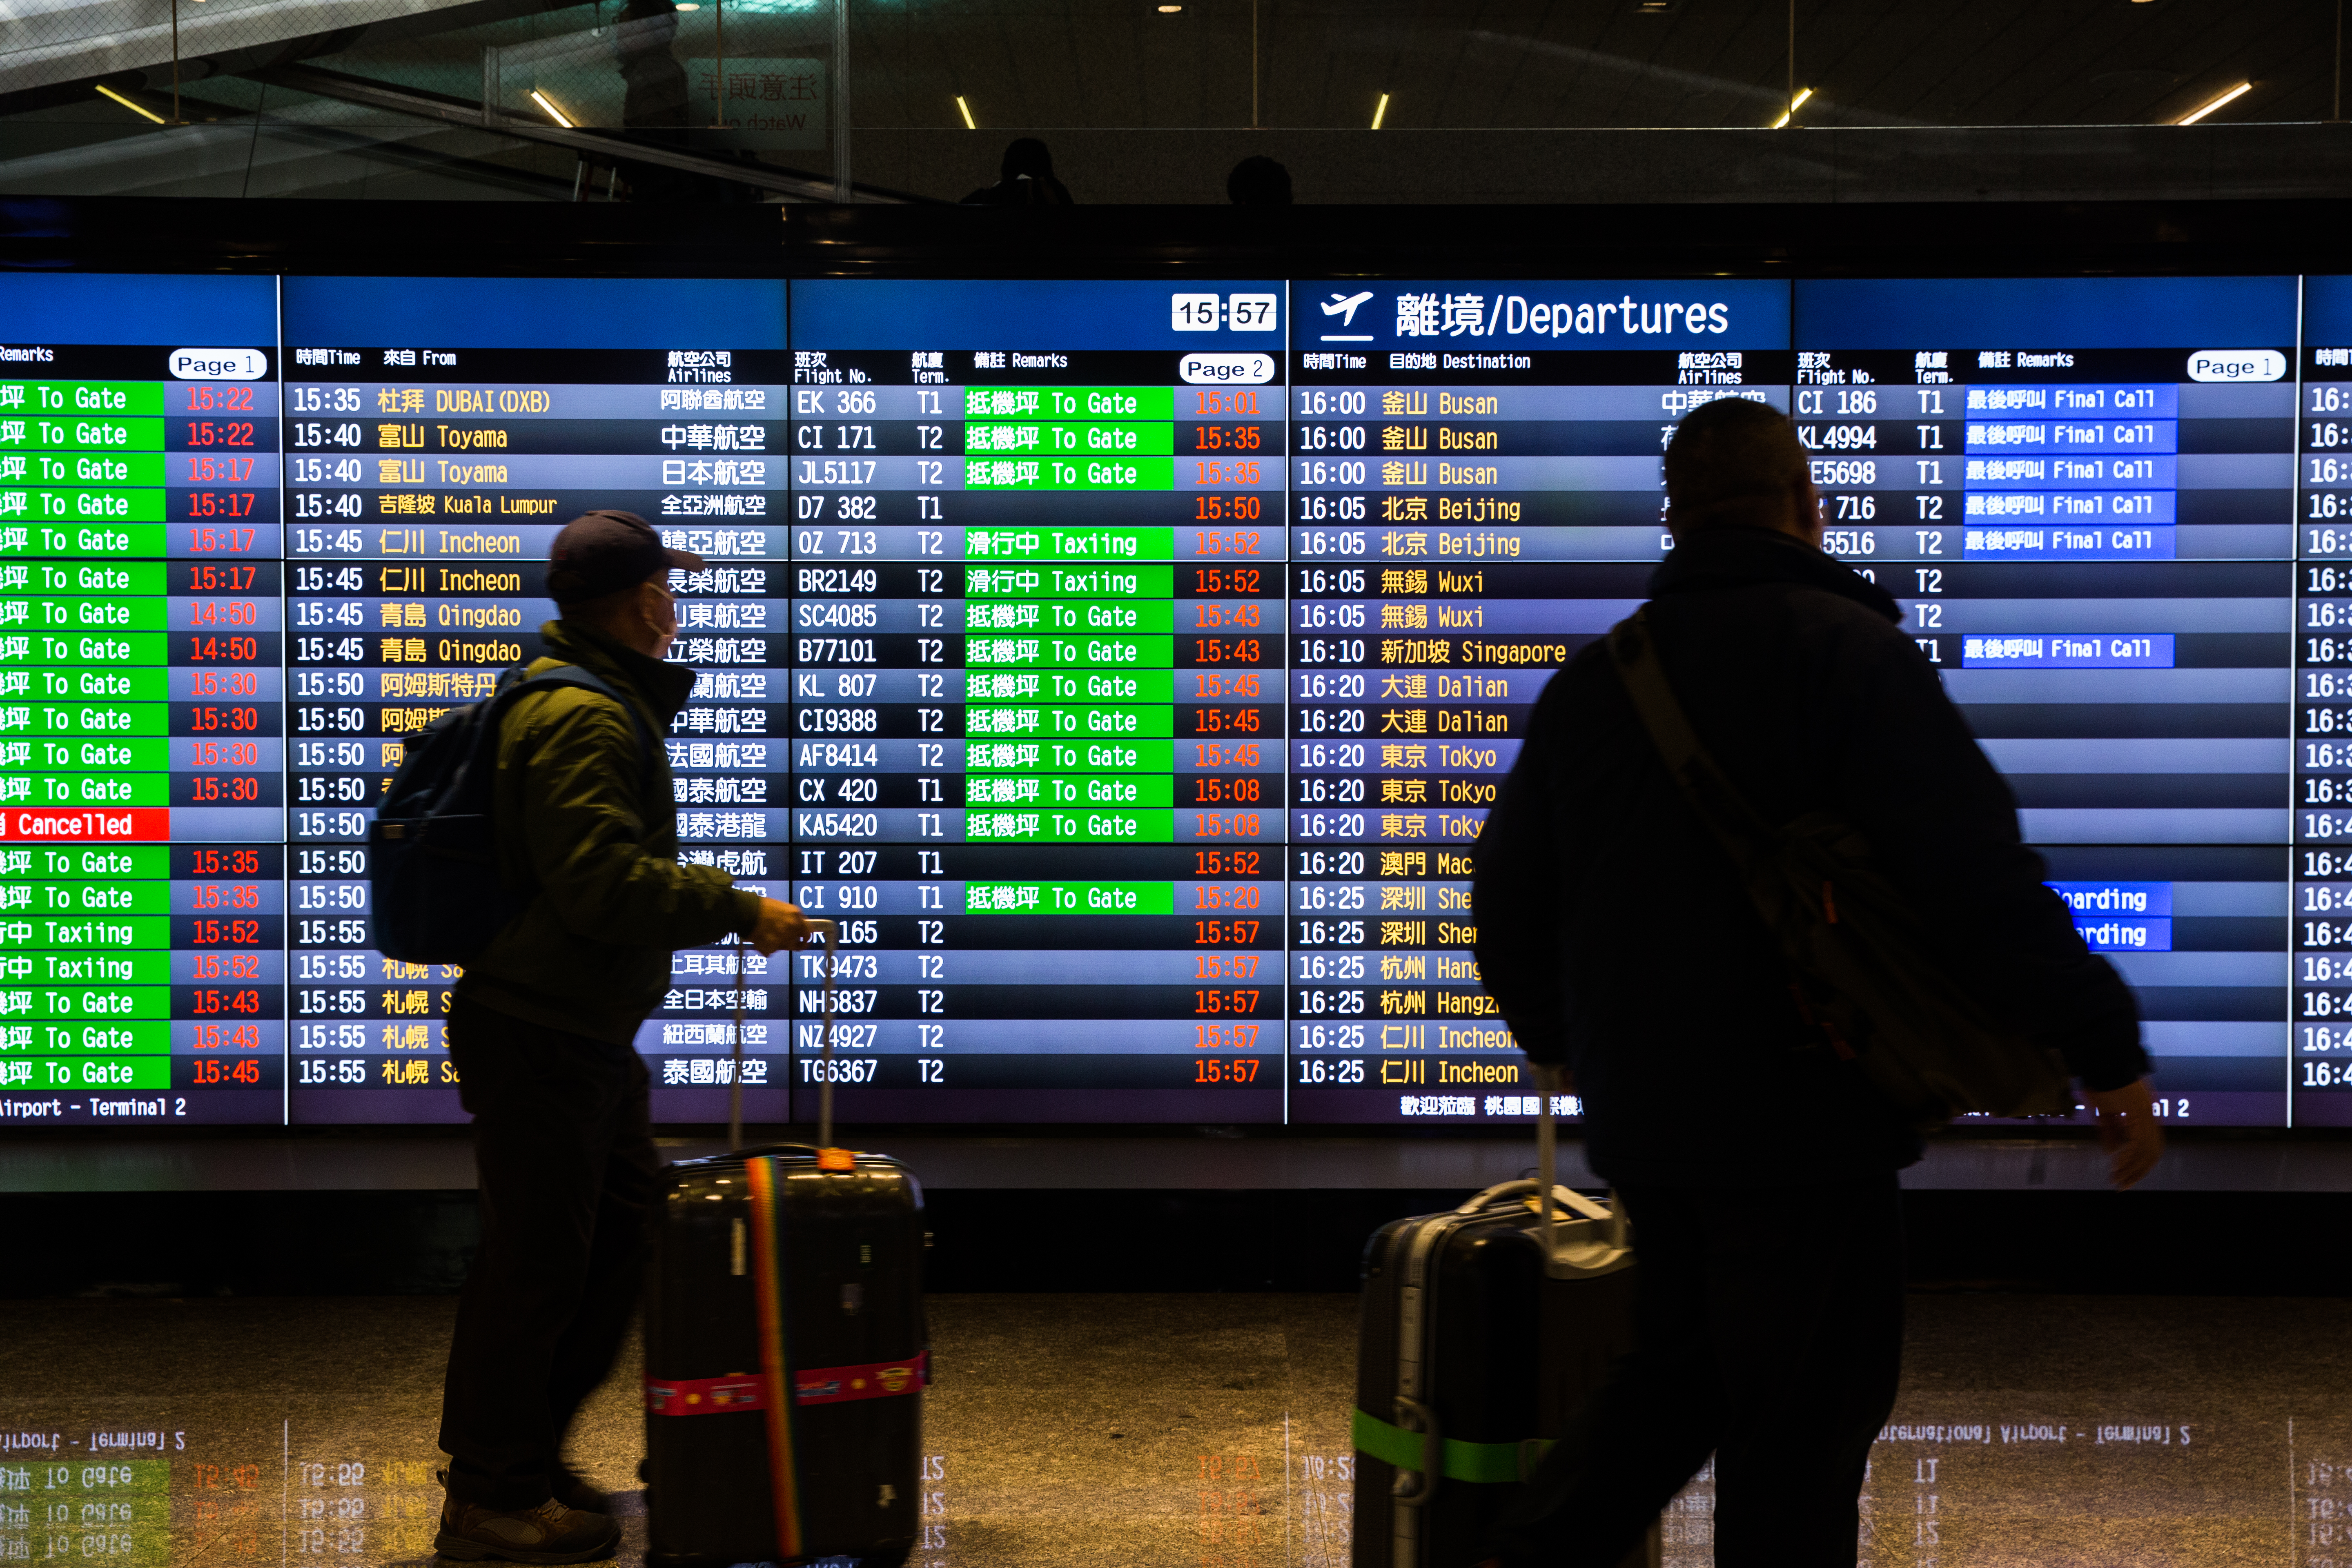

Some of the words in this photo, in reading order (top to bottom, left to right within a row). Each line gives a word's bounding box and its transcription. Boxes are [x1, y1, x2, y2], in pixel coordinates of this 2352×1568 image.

[1179, 301, 1270, 324] 15:57
[1397, 293, 1728, 337] 離境/Departures
[0, 346, 53, 361] Remarks
[296, 349, 360, 365] 時間Time
[384, 350, 415, 365] 來自
[423, 350, 456, 365] From
[668, 351, 730, 367] 航空公司
[795, 352, 826, 367] 班次
[974, 352, 1005, 368] 備註
[1013, 353, 1067, 367] Remarks
[1304, 353, 1366, 369] 時間Time
[1390, 353, 1437, 369] 目的地
[1444, 354, 1530, 368] Destination
[1679, 352, 1742, 368] 航空公司
[1798, 352, 1830, 368] 班次
[1979, 352, 2011, 368] 備註
[2018, 352, 2074, 367] Remarks
[178, 357, 236, 376] Page
[246, 356, 255, 373] 1
[668, 368, 731, 382] Airlines
[795, 369, 842, 384] Flight
[850, 369, 871, 383] No.
[912, 369, 949, 383] Term.
[1187, 362, 1245, 380] Page
[1254, 360, 1263, 376] 2
[1679, 370, 1742, 384] Airlines
[1798, 369, 1845, 385] Flight
[1853, 369, 1875, 383] No.
[1916, 369, 1953, 383] Term.
[2196, 360, 2254, 378] Page
[2264, 359, 2272, 375] 1
[38, 387, 62, 408] To
[76, 388, 125, 408] Gate
[187, 387, 253, 410] 15:22
[294, 388, 360, 411] 15:35
[378, 388, 425, 413] 杜拜
[437, 390, 550, 412] DUBAI(DXB)
[661, 389, 765, 410] 阿聯酋航空
[798, 391, 824, 413] EK
[837, 391, 875, 413] 366
[917, 391, 942, 413] T1
[967, 391, 1039, 414] 抵機坪
[1052, 393, 1076, 413] To
[1088, 393, 1136, 413] Gate
[1196, 391, 1260, 414] 15:01
[1301, 392, 1365, 414] 16:00
[1382, 391, 1427, 414] 釜山
[1440, 392, 1497, 414] Busan
[1799, 391, 1823, 413] CI
[1838, 391, 1876, 413] 186
[1918, 390, 1944, 413] T1
[1967, 390, 2046, 409] 最後呼叫
[2056, 390, 2104, 408] Final
[2115, 390, 2154, 408] Call
[295, 423, 361, 446] 15:40
[378, 423, 424, 447] 富山
[437, 425, 507, 449] Toyama
[662, 424, 765, 450] 中華航空
[799, 426, 822, 448] CI
[838, 426, 875, 448] 171
[918, 426, 942, 448] T2
[1196, 427, 1260, 449] 15:35
[1799, 426, 1876, 448] KL4994
[663, 459, 765, 485] 日本航空
[799, 461, 876, 483] JL5117
[296, 494, 361, 517] 15:40
[379, 494, 435, 514] 吉隆坡
[445, 496, 491, 513] Kuala
[501, 496, 557, 515] Lumpur
[662, 494, 765, 515] 全亞洲航空
[799, 496, 824, 518] D7
[838, 497, 876, 519] 382
[1196, 497, 1260, 519] 15:50
[379, 529, 424, 554] 仁川
[439, 531, 520, 553] Incheon
[1301, 532, 1365, 554] 16:05
[1381, 531, 1428, 556] 北京
[1439, 532, 1520, 557] Beijing
[1916, 531, 1942, 554] T2
[297, 568, 362, 590] 15:45
[800, 570, 876, 591] BR2149
[918, 570, 942, 592] T2
[968, 570, 1039, 592] 滑行中
[1052, 571, 1136, 593] Taxiing
[1196, 570, 1259, 592] 15:52
[1382, 569, 1427, 593] 無錫
[1439, 571, 1482, 592] Wuxi
[191, 602, 256, 625] 14:50
[380, 602, 426, 627] 青島
[439, 604, 521, 628] Qingdao
[800, 604, 876, 626] SC4085
[663, 638, 766, 663] 立榮航空
[800, 639, 876, 662] B77101
[1301, 640, 1364, 662] 16:10
[1381, 639, 1450, 663] 新加坡
[1463, 641, 1566, 664] Singapore
[381, 673, 495, 697] 阿姆斯特丹
[1381, 674, 1427, 698] 大連
[1439, 675, 1507, 697] Dalian
[665, 742, 766, 768] 法國航空
[800, 744, 878, 766] AF8414
[1301, 744, 1364, 766] 16:20
[1381, 744, 1427, 768] 東京
[1439, 745, 1496, 768] Tokyo
[800, 779, 824, 801] CX
[838, 779, 876, 801] 420
[1196, 779, 1259, 801] 15:08
[19, 813, 132, 835] Cancelled
[299, 813, 364, 835] 15:50
[800, 814, 877, 835] KA5420
[802, 852, 825, 873] IT
[839, 852, 876, 873] 207
[1381, 852, 1425, 875] 澳門
[1381, 886, 1425, 910] 深圳
[46, 922, 132, 944] Taxiing
[1300, 956, 1364, 978] 16:25
[1381, 956, 1425, 980] 杭州
[800, 1025, 877, 1047] NZ4927
[46, 1062, 70, 1083] To
[83, 1062, 132, 1082] Gate
[194, 1060, 259, 1083] 15:45
[300, 1060, 365, 1082] 15:55
[382, 1060, 429, 1084] 札幌
[800, 1060, 877, 1082] TG6367
[1196, 1060, 1259, 1082] 15:57
[1381, 1060, 1424, 1084] 仁川
[1439, 1061, 1518, 1082] Incheon
[90, 1098, 165, 1115] Terminal
[176, 1098, 186, 1115] 2
[1401, 1096, 1476, 1116] 歡迎蒞臨
[2178, 1098, 2189, 1117] 2
